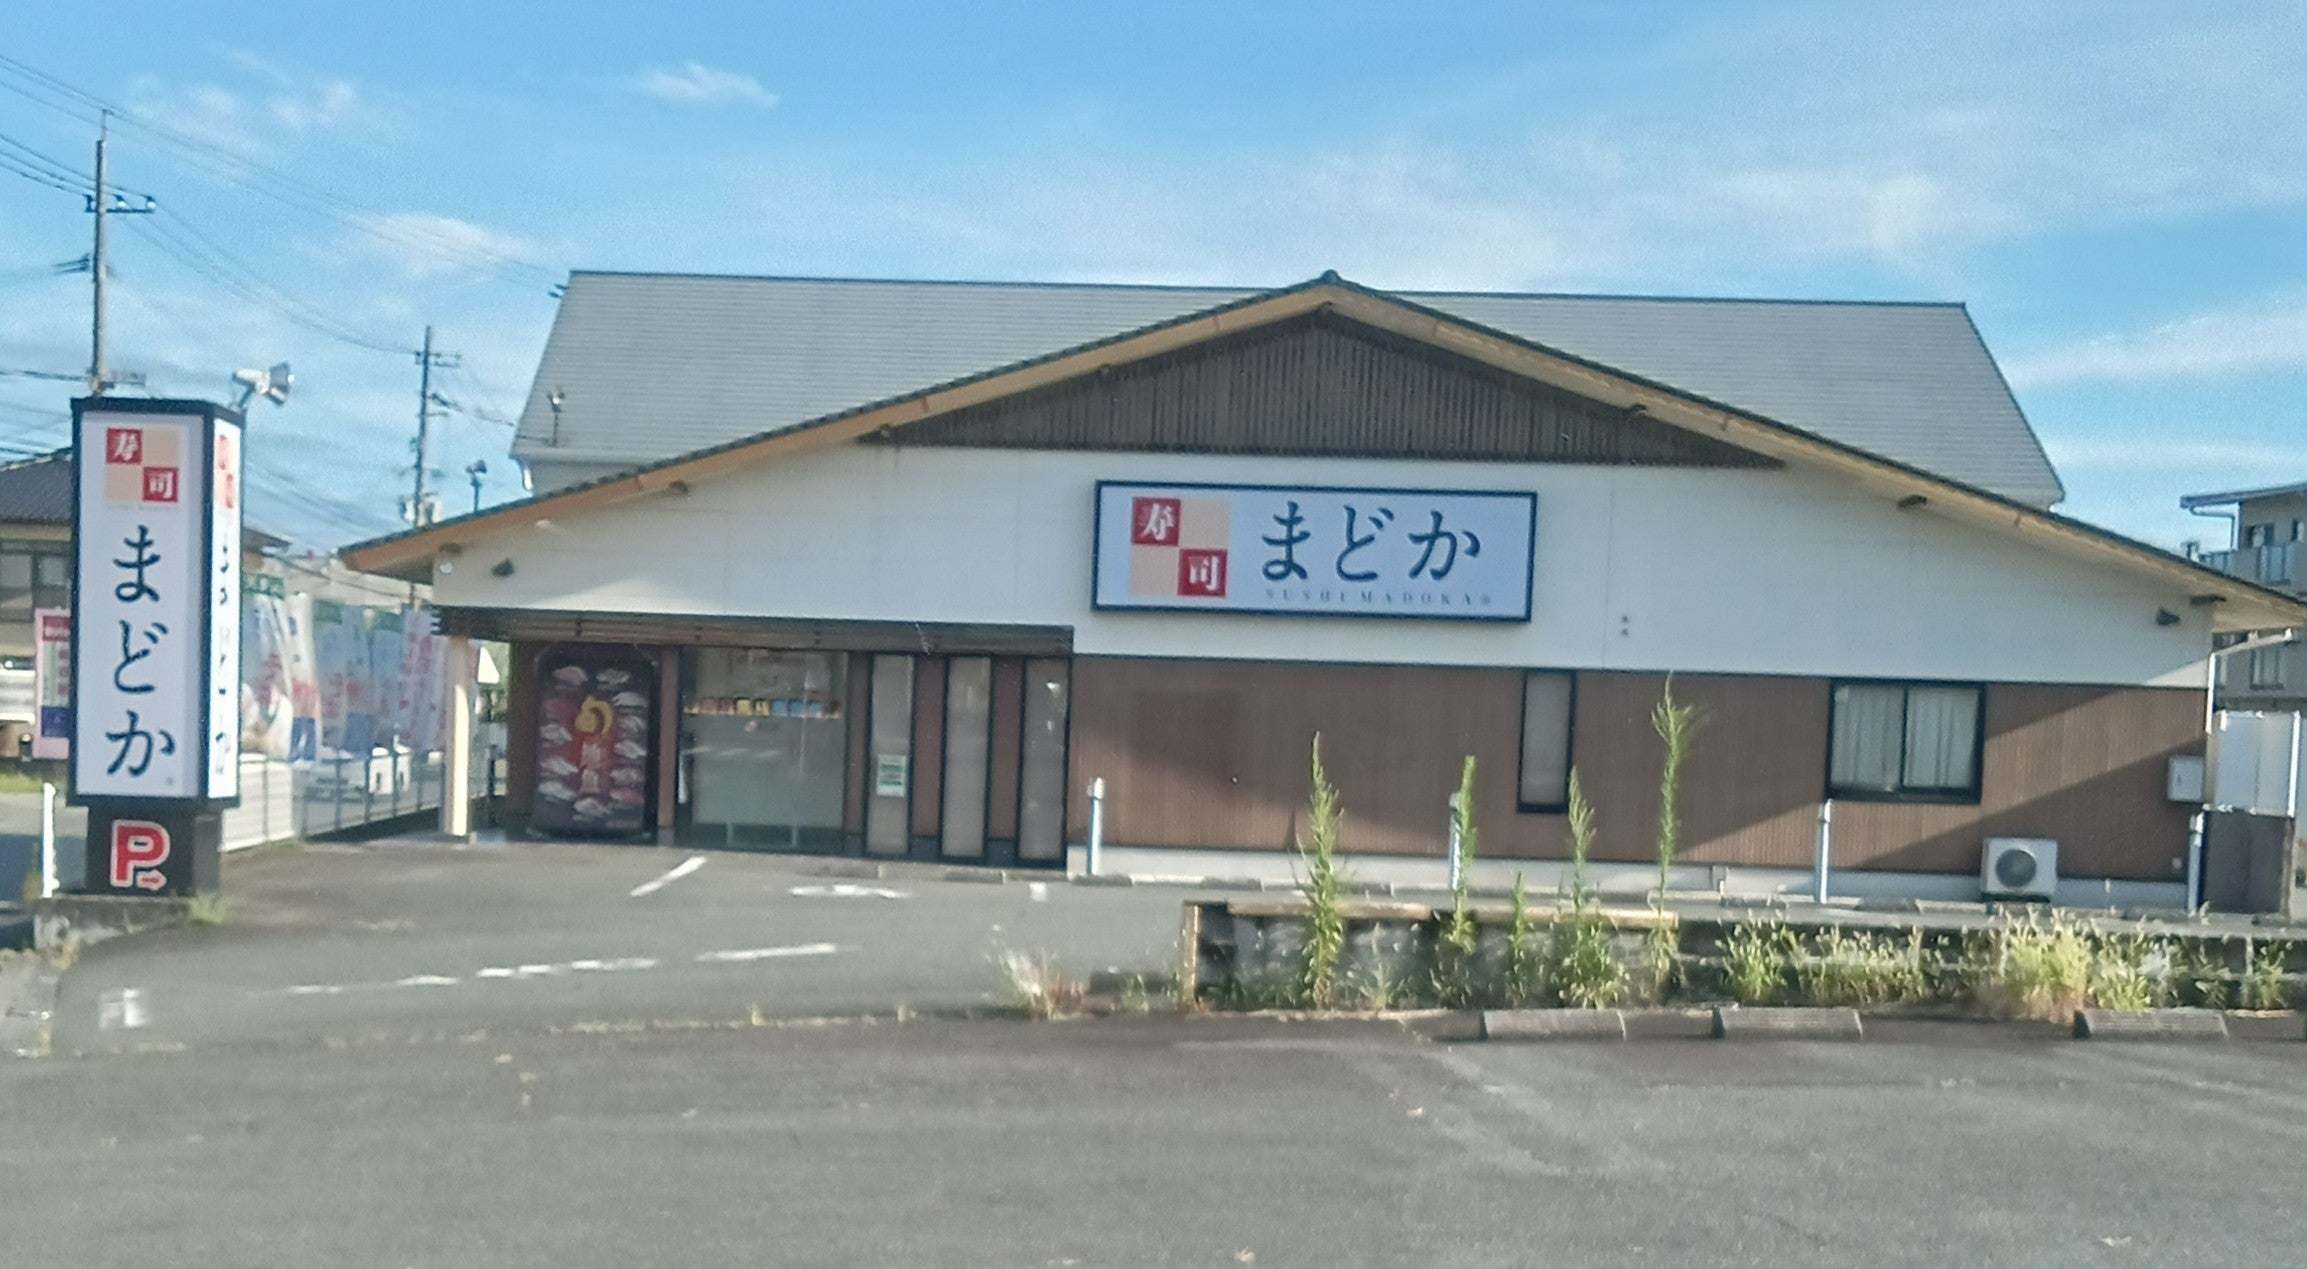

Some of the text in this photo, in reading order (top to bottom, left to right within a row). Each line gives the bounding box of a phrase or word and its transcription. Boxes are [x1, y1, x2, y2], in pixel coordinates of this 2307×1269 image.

[1262, 501, 1481, 581] まどか
[105, 524, 176, 777] まどか
[110, 819, 170, 888] P
